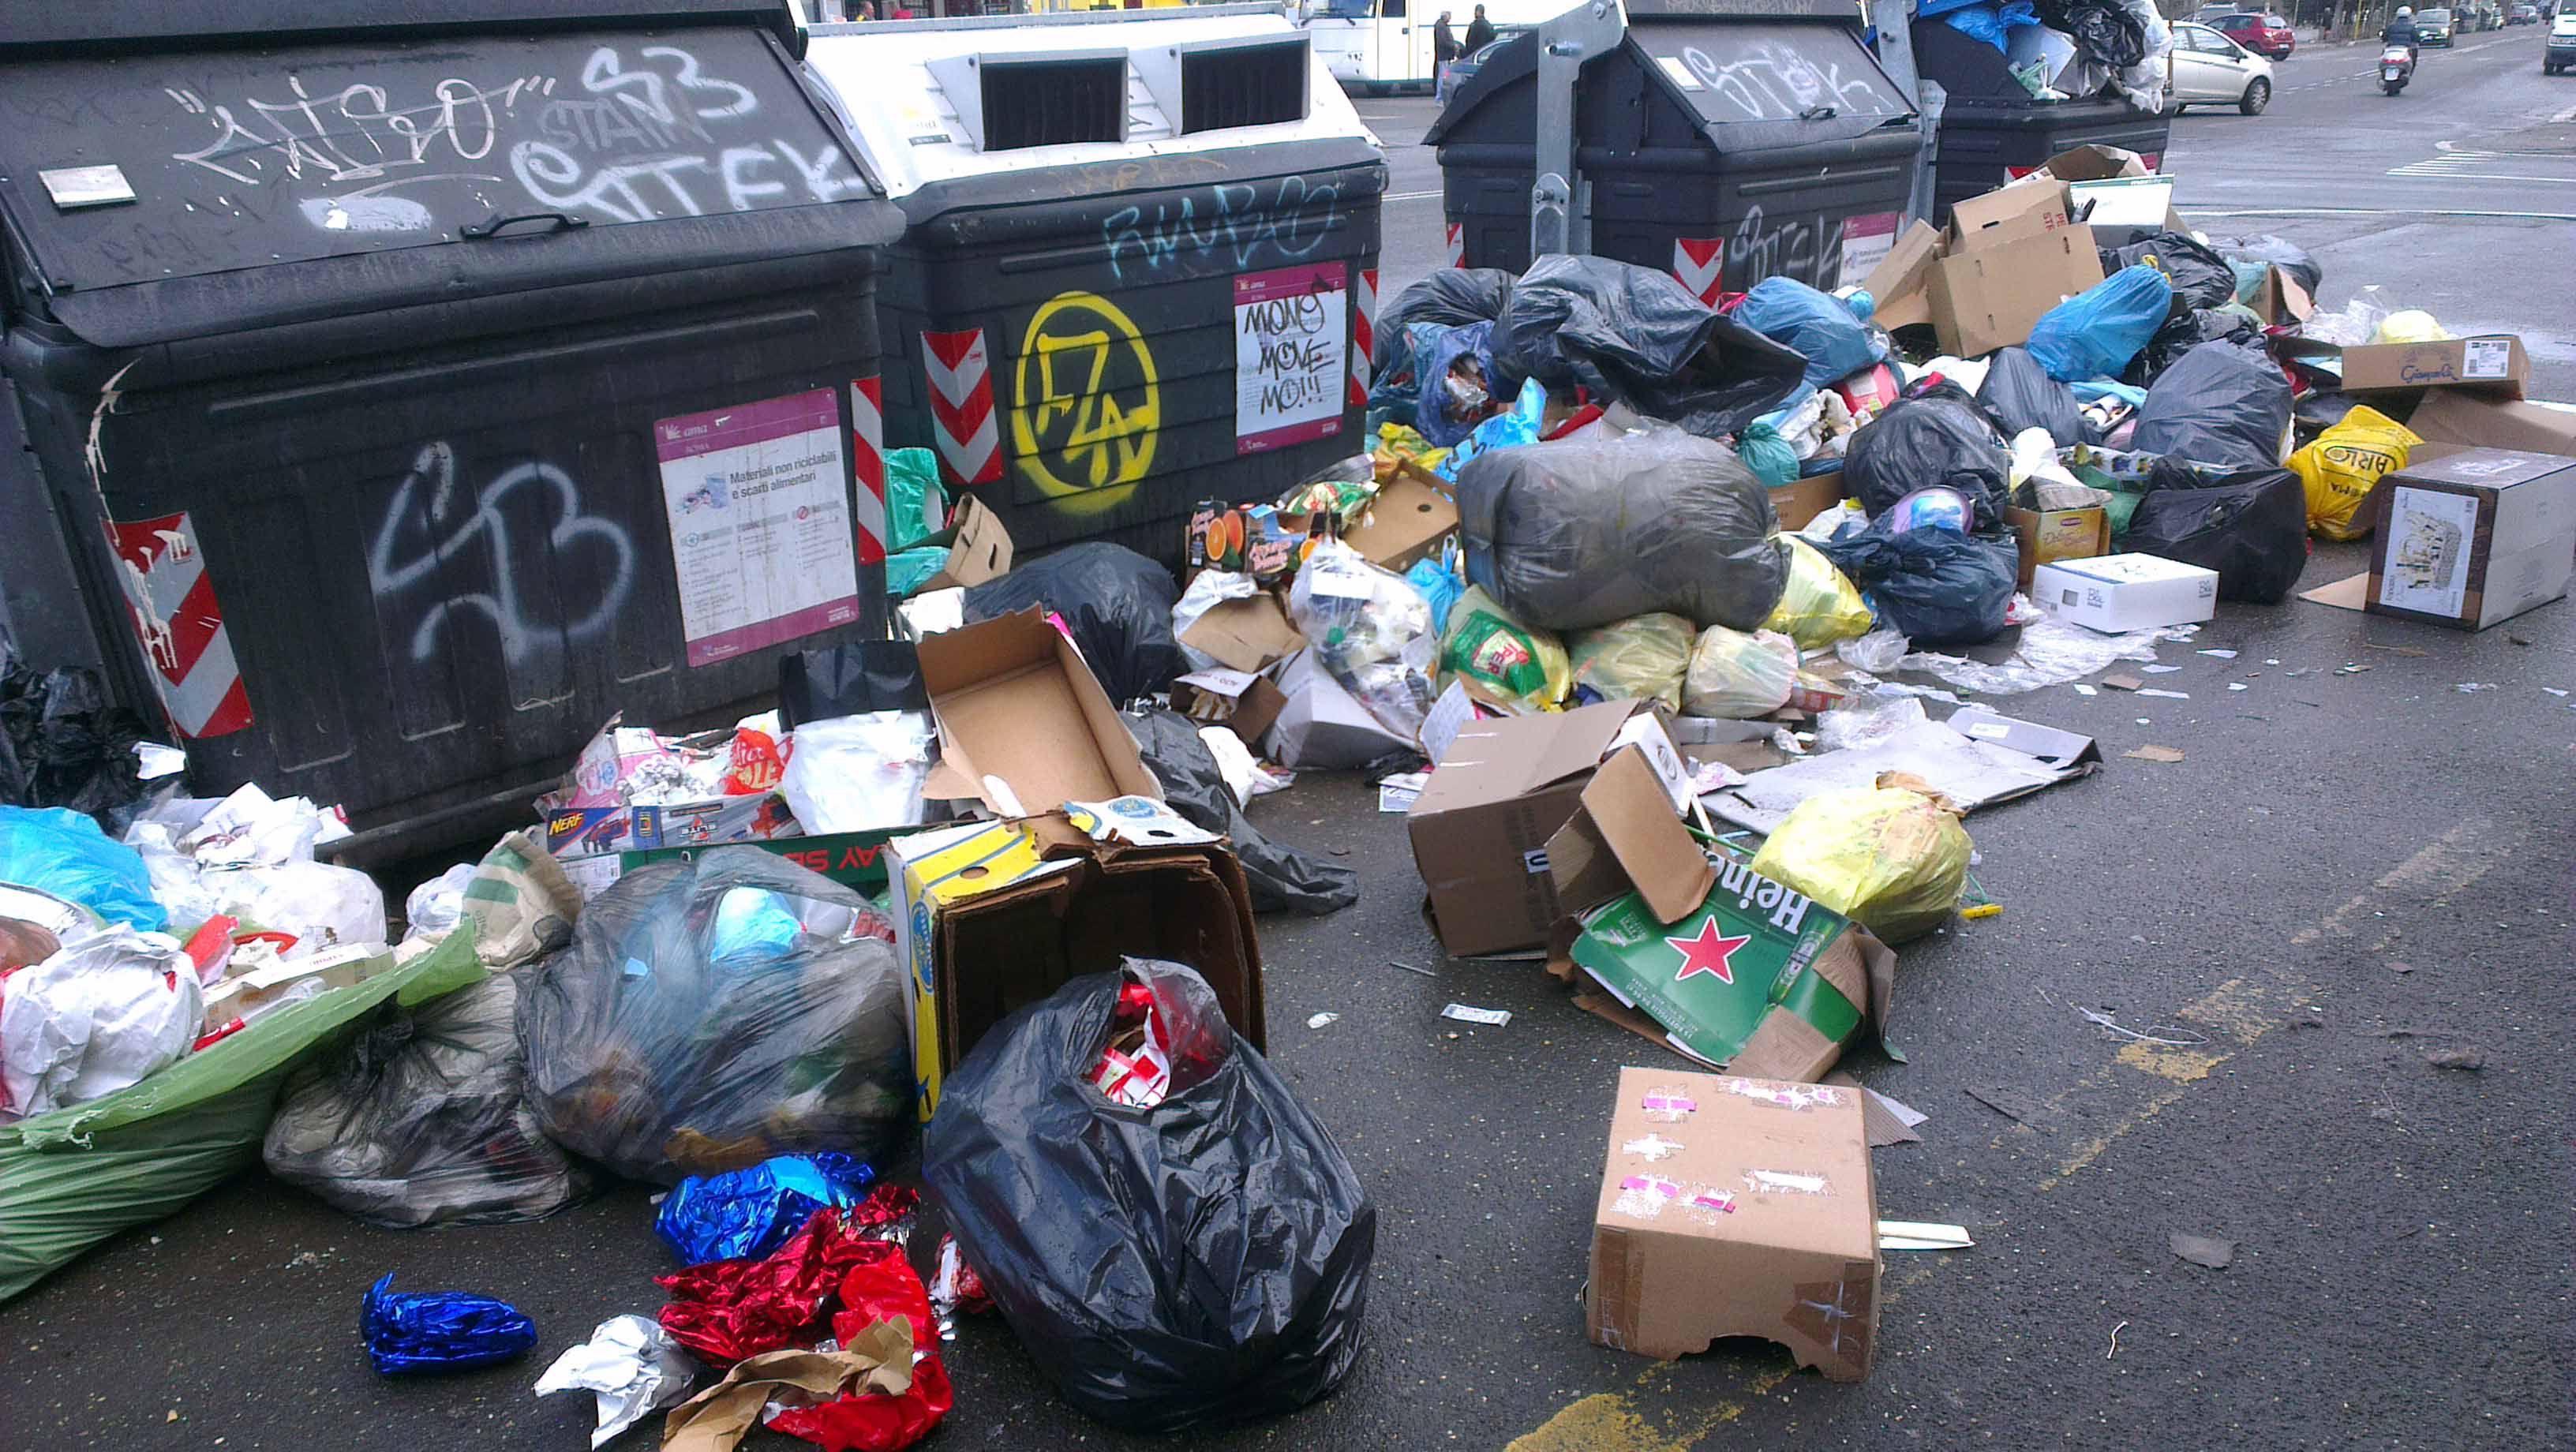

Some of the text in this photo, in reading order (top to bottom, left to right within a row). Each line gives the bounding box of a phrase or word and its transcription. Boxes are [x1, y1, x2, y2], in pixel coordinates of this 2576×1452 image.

[1259, 339, 1335, 380] MOVE
[730, 451, 837, 484] Materiali non riciclabili
[732, 473, 816, 500] e scarti alimentari
[549, 812, 583, 836] NERF
[1702, 843, 1814, 935] Heine
